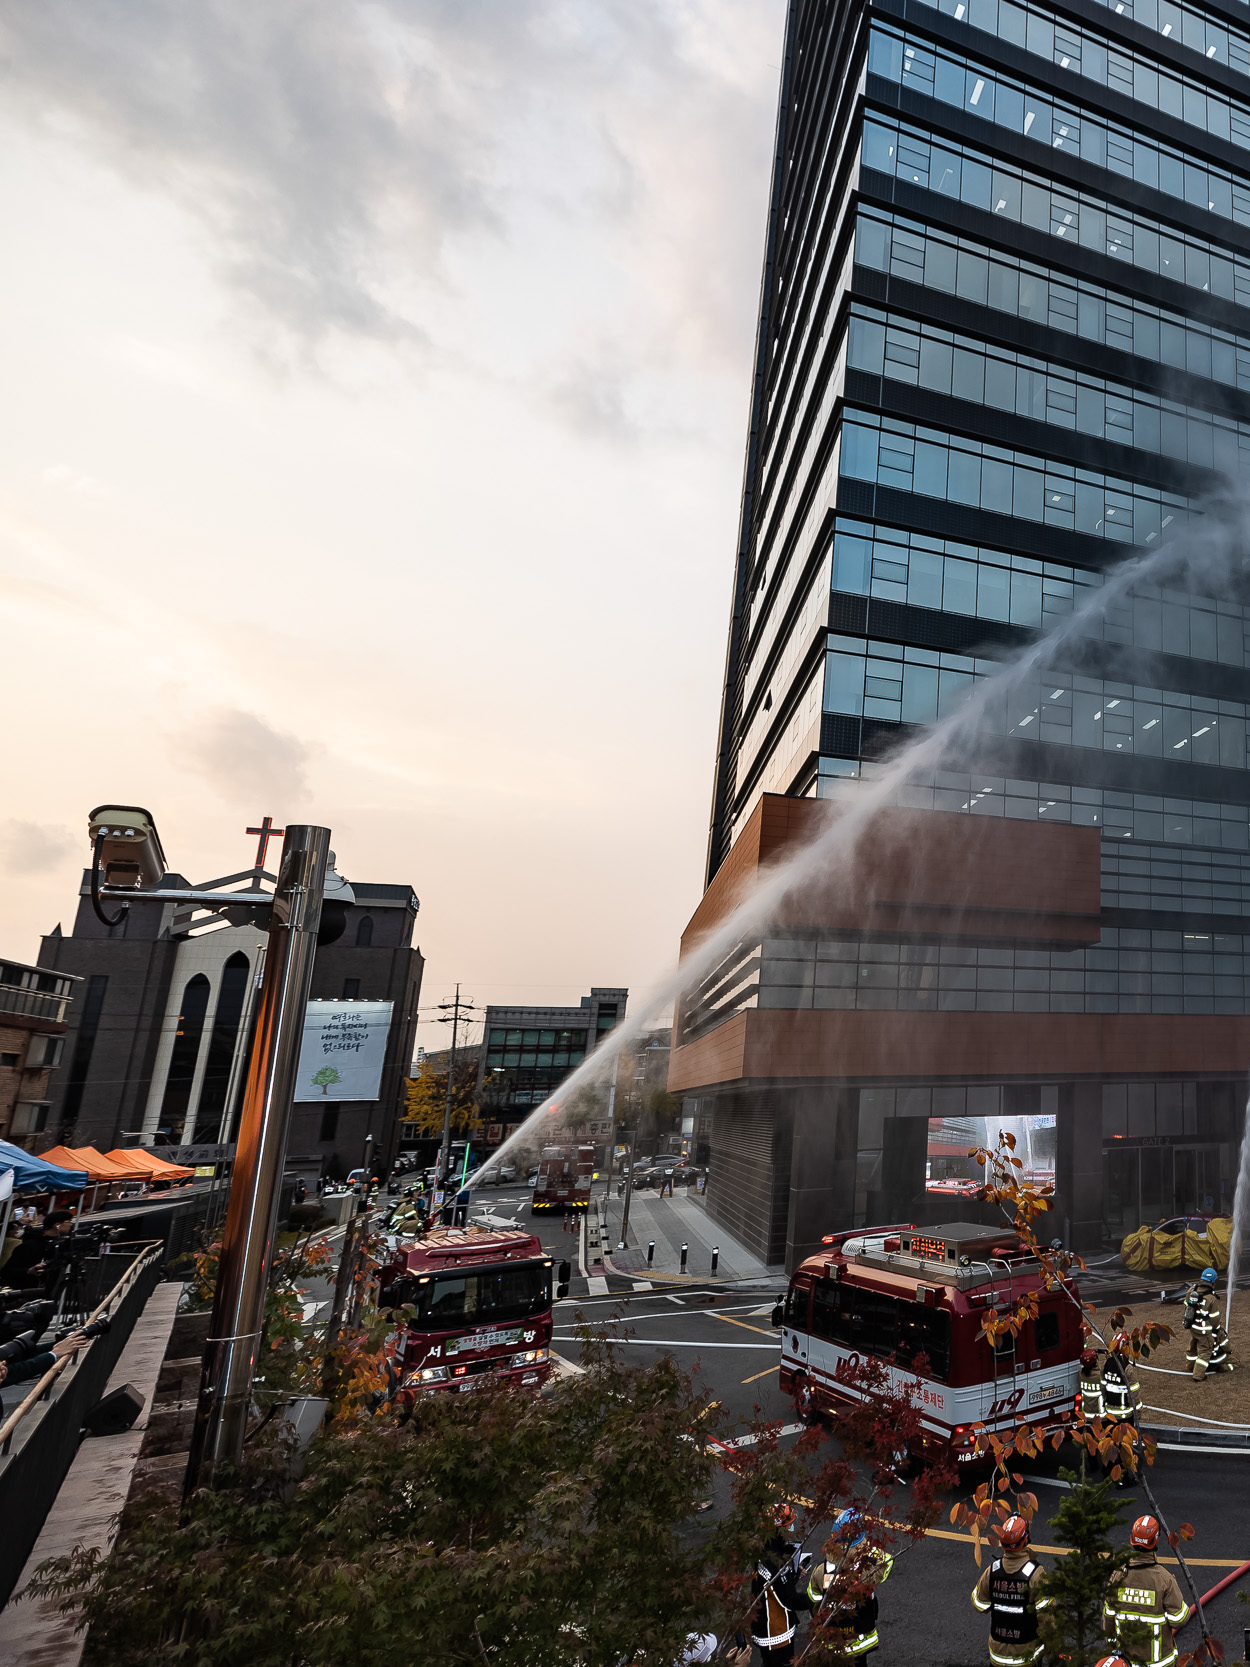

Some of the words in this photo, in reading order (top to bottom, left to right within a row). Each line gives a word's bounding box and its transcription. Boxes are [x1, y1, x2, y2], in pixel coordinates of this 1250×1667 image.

[986, 1387, 1025, 1418] 119
[992, 1579, 1026, 1593] 서울소방
[992, 1591, 1010, 1600] SEOUL
